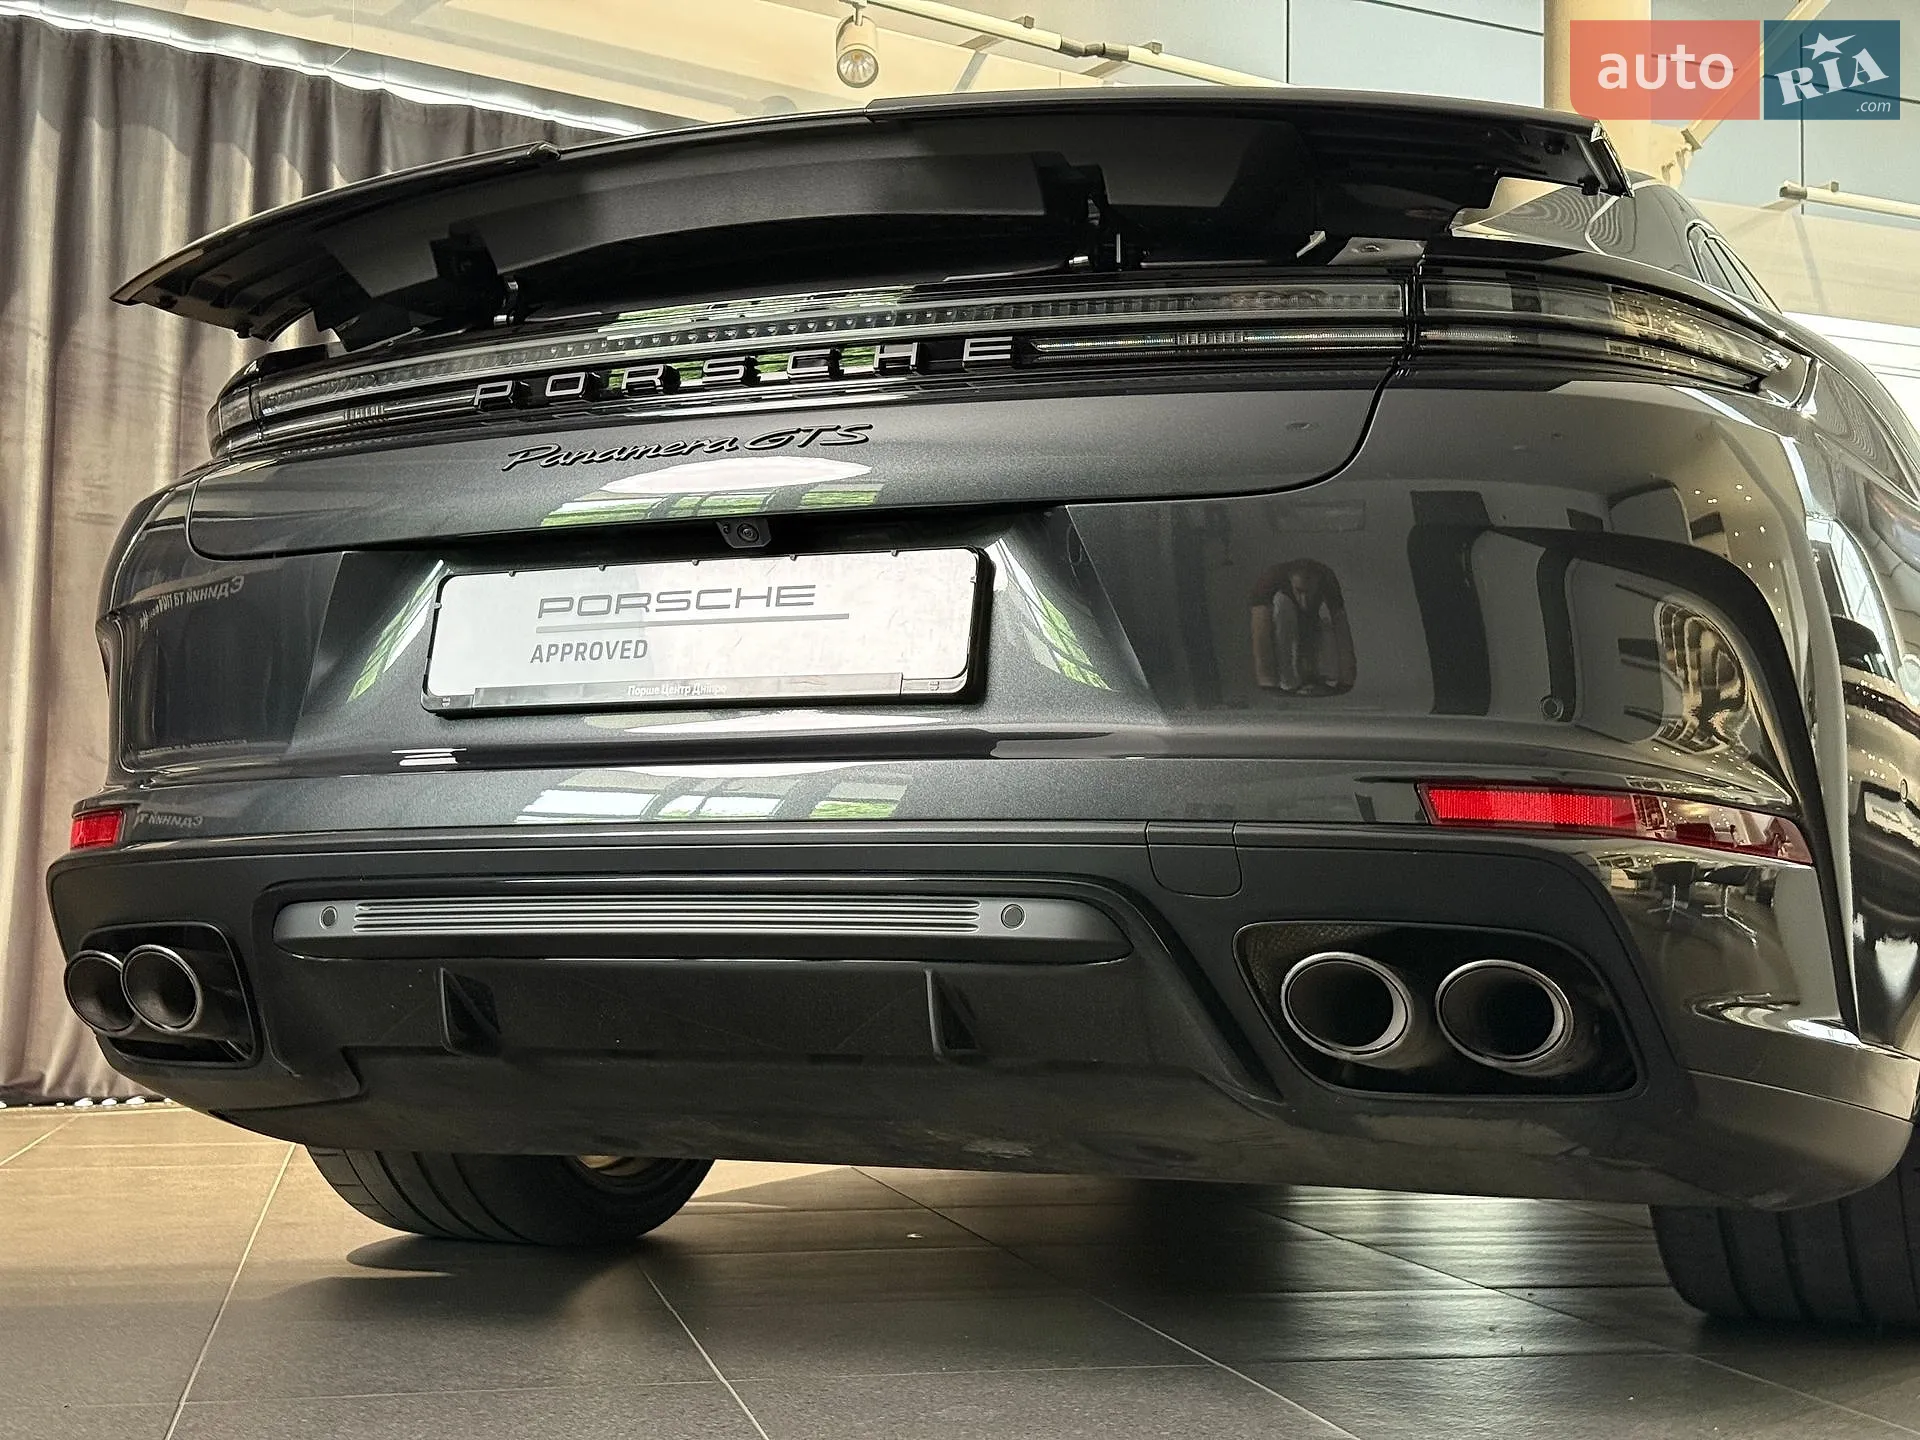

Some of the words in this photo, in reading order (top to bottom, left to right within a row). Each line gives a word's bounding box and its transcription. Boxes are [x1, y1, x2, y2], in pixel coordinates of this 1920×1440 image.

[471, 336, 1015, 410] PORSCHE
[502, 436, 739, 472] Panamera
[743, 423, 874, 451] GTS
[537, 584, 817, 619] PORSCHE
[530, 639, 649, 664] APPROVED
